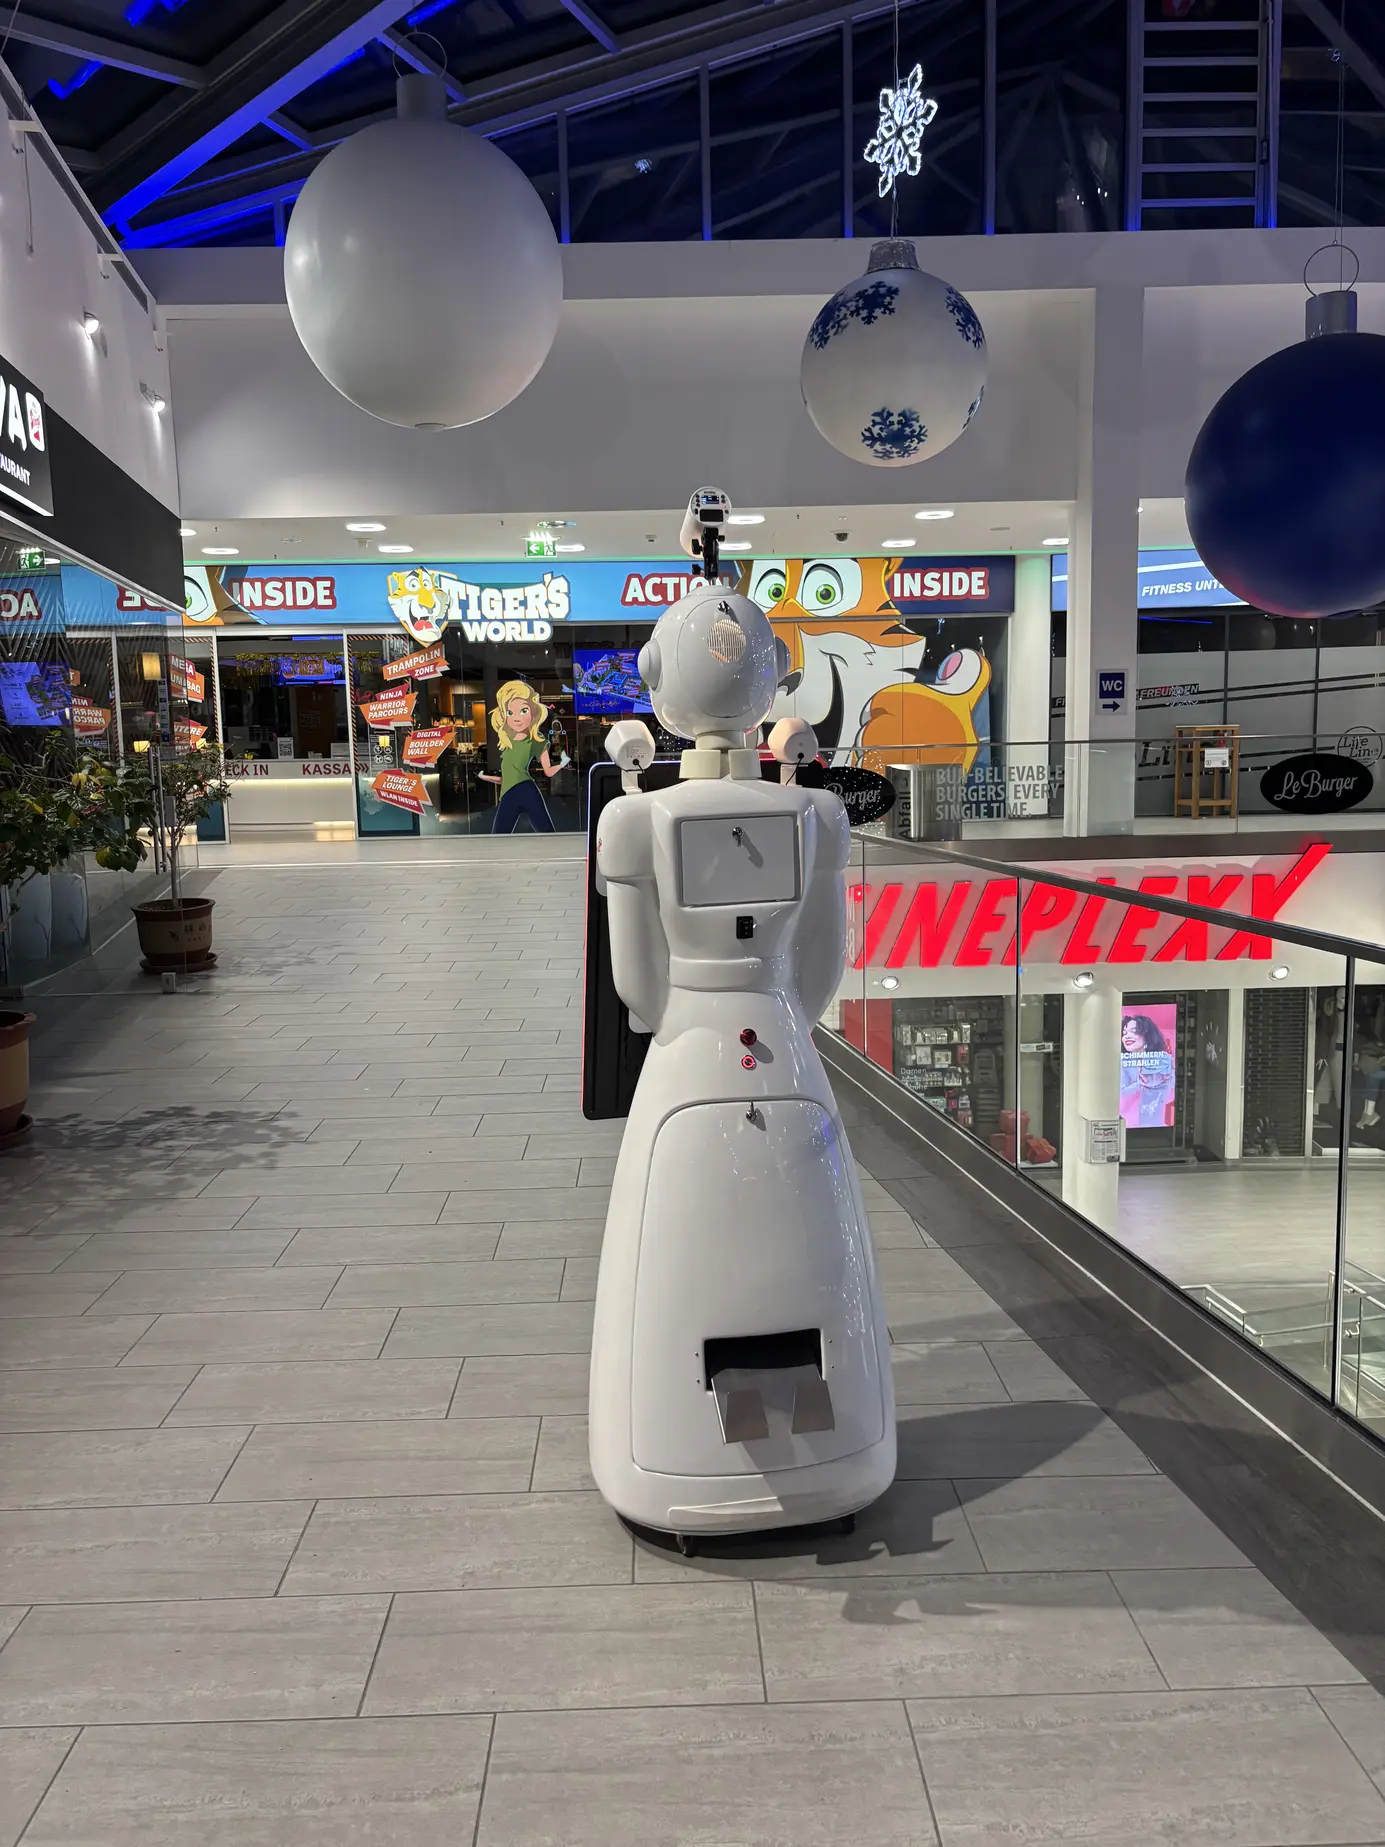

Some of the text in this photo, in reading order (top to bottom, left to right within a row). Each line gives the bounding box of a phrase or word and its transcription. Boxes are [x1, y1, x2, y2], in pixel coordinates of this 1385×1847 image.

[893, 571, 986, 597] INSIDE
[1141, 582, 1192, 597] FITNESS
[232, 580, 331, 607] INSIDE
[441, 572, 569, 619] TIGER'S
[462, 621, 551, 642] WORLD
[386, 648, 441, 676] TRAMPOLIN
[414, 665, 434, 677] ZONE
[1102, 680, 1123, 691] WC
[379, 690, 403, 701] NINJA
[369, 700, 406, 711] WARRIOR
[368, 707, 408, 719] PARCOURS
[416, 731, 441, 739] DIGITAL
[409, 740, 445, 749] BOULDER
[407, 748, 428, 756] WALL
[253, 764, 269, 776] IN
[302, 763, 352, 775] KASSA
[382, 782, 414, 793] LOUNGE
[1273, 769, 1358, 801] Le Burger
[1013, 783, 1060, 800] EVERY
[380, 790, 419, 806] WLAN INSIDE
[899, 791, 912, 839] Abfall
[935, 804, 988, 821] SINGLE
[1122, 1059, 1160, 1067] STRAHLEN
